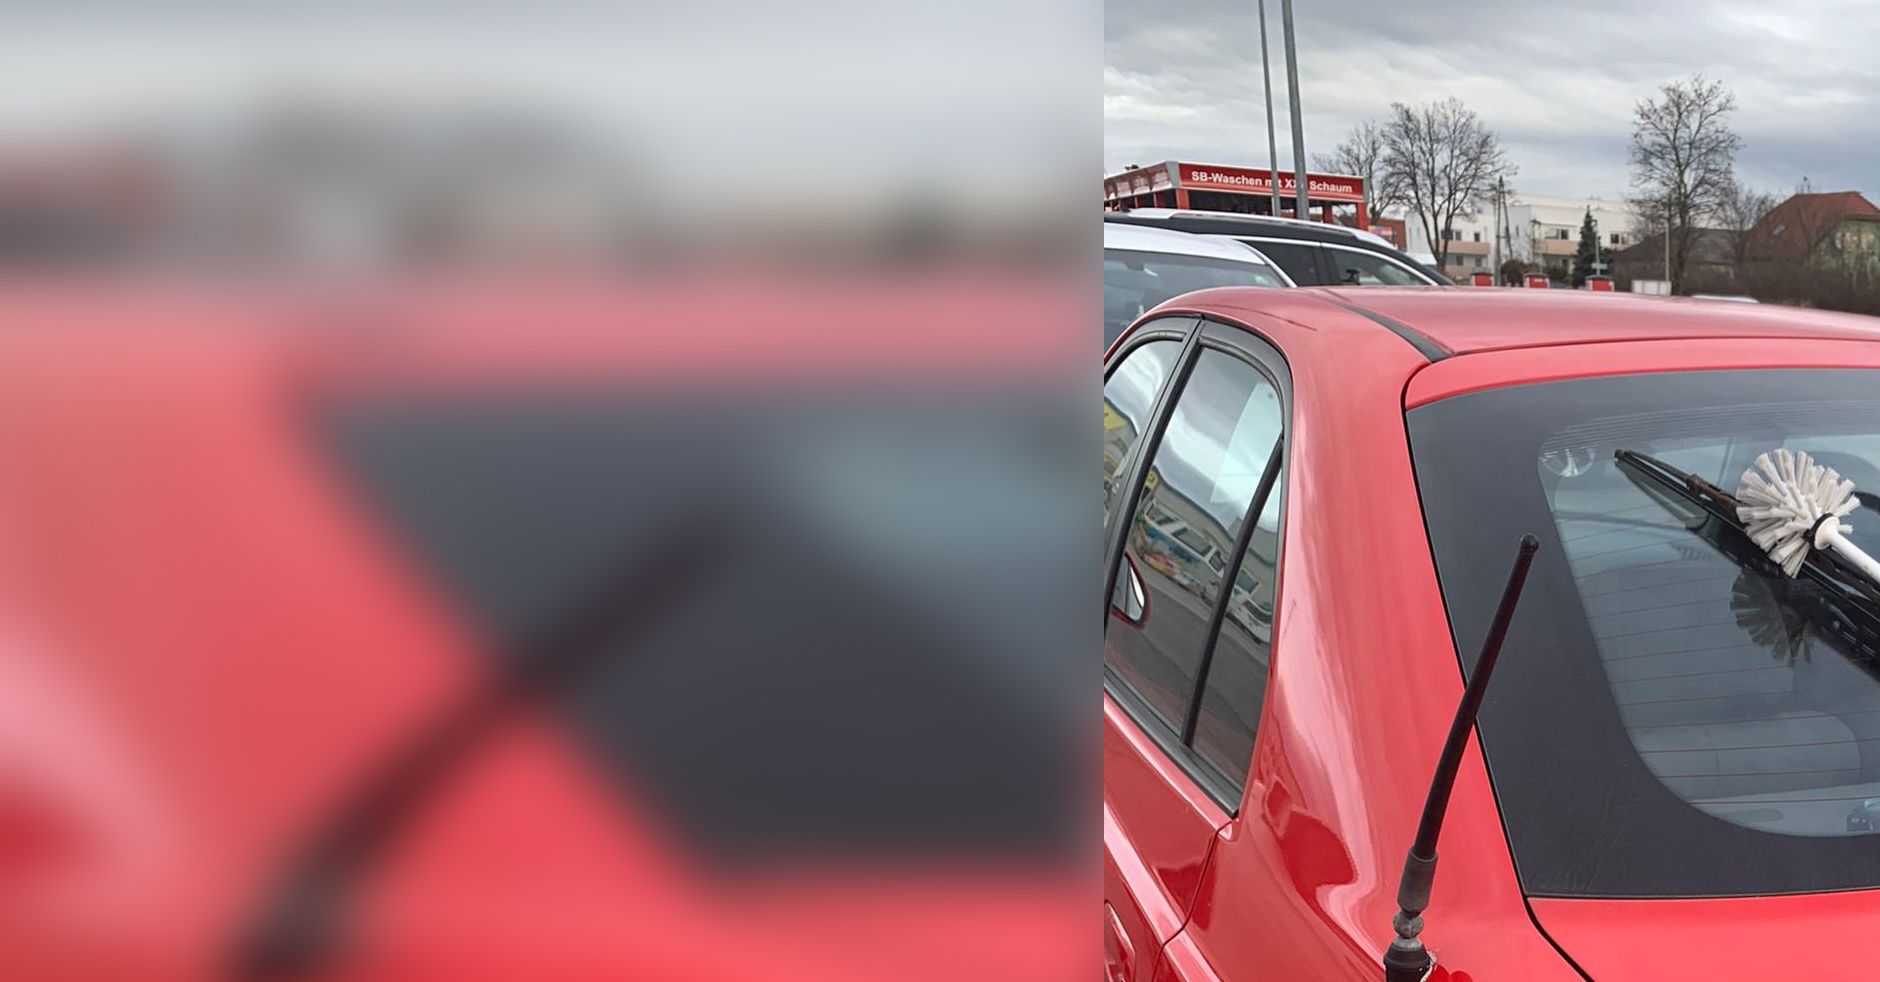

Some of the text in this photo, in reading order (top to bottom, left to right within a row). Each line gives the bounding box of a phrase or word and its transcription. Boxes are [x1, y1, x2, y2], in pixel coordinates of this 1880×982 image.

[1191, 171, 1263, 188] SB-Waschen
[1264, 177, 1283, 188] mt
[1309, 180, 1353, 193] Schaum
